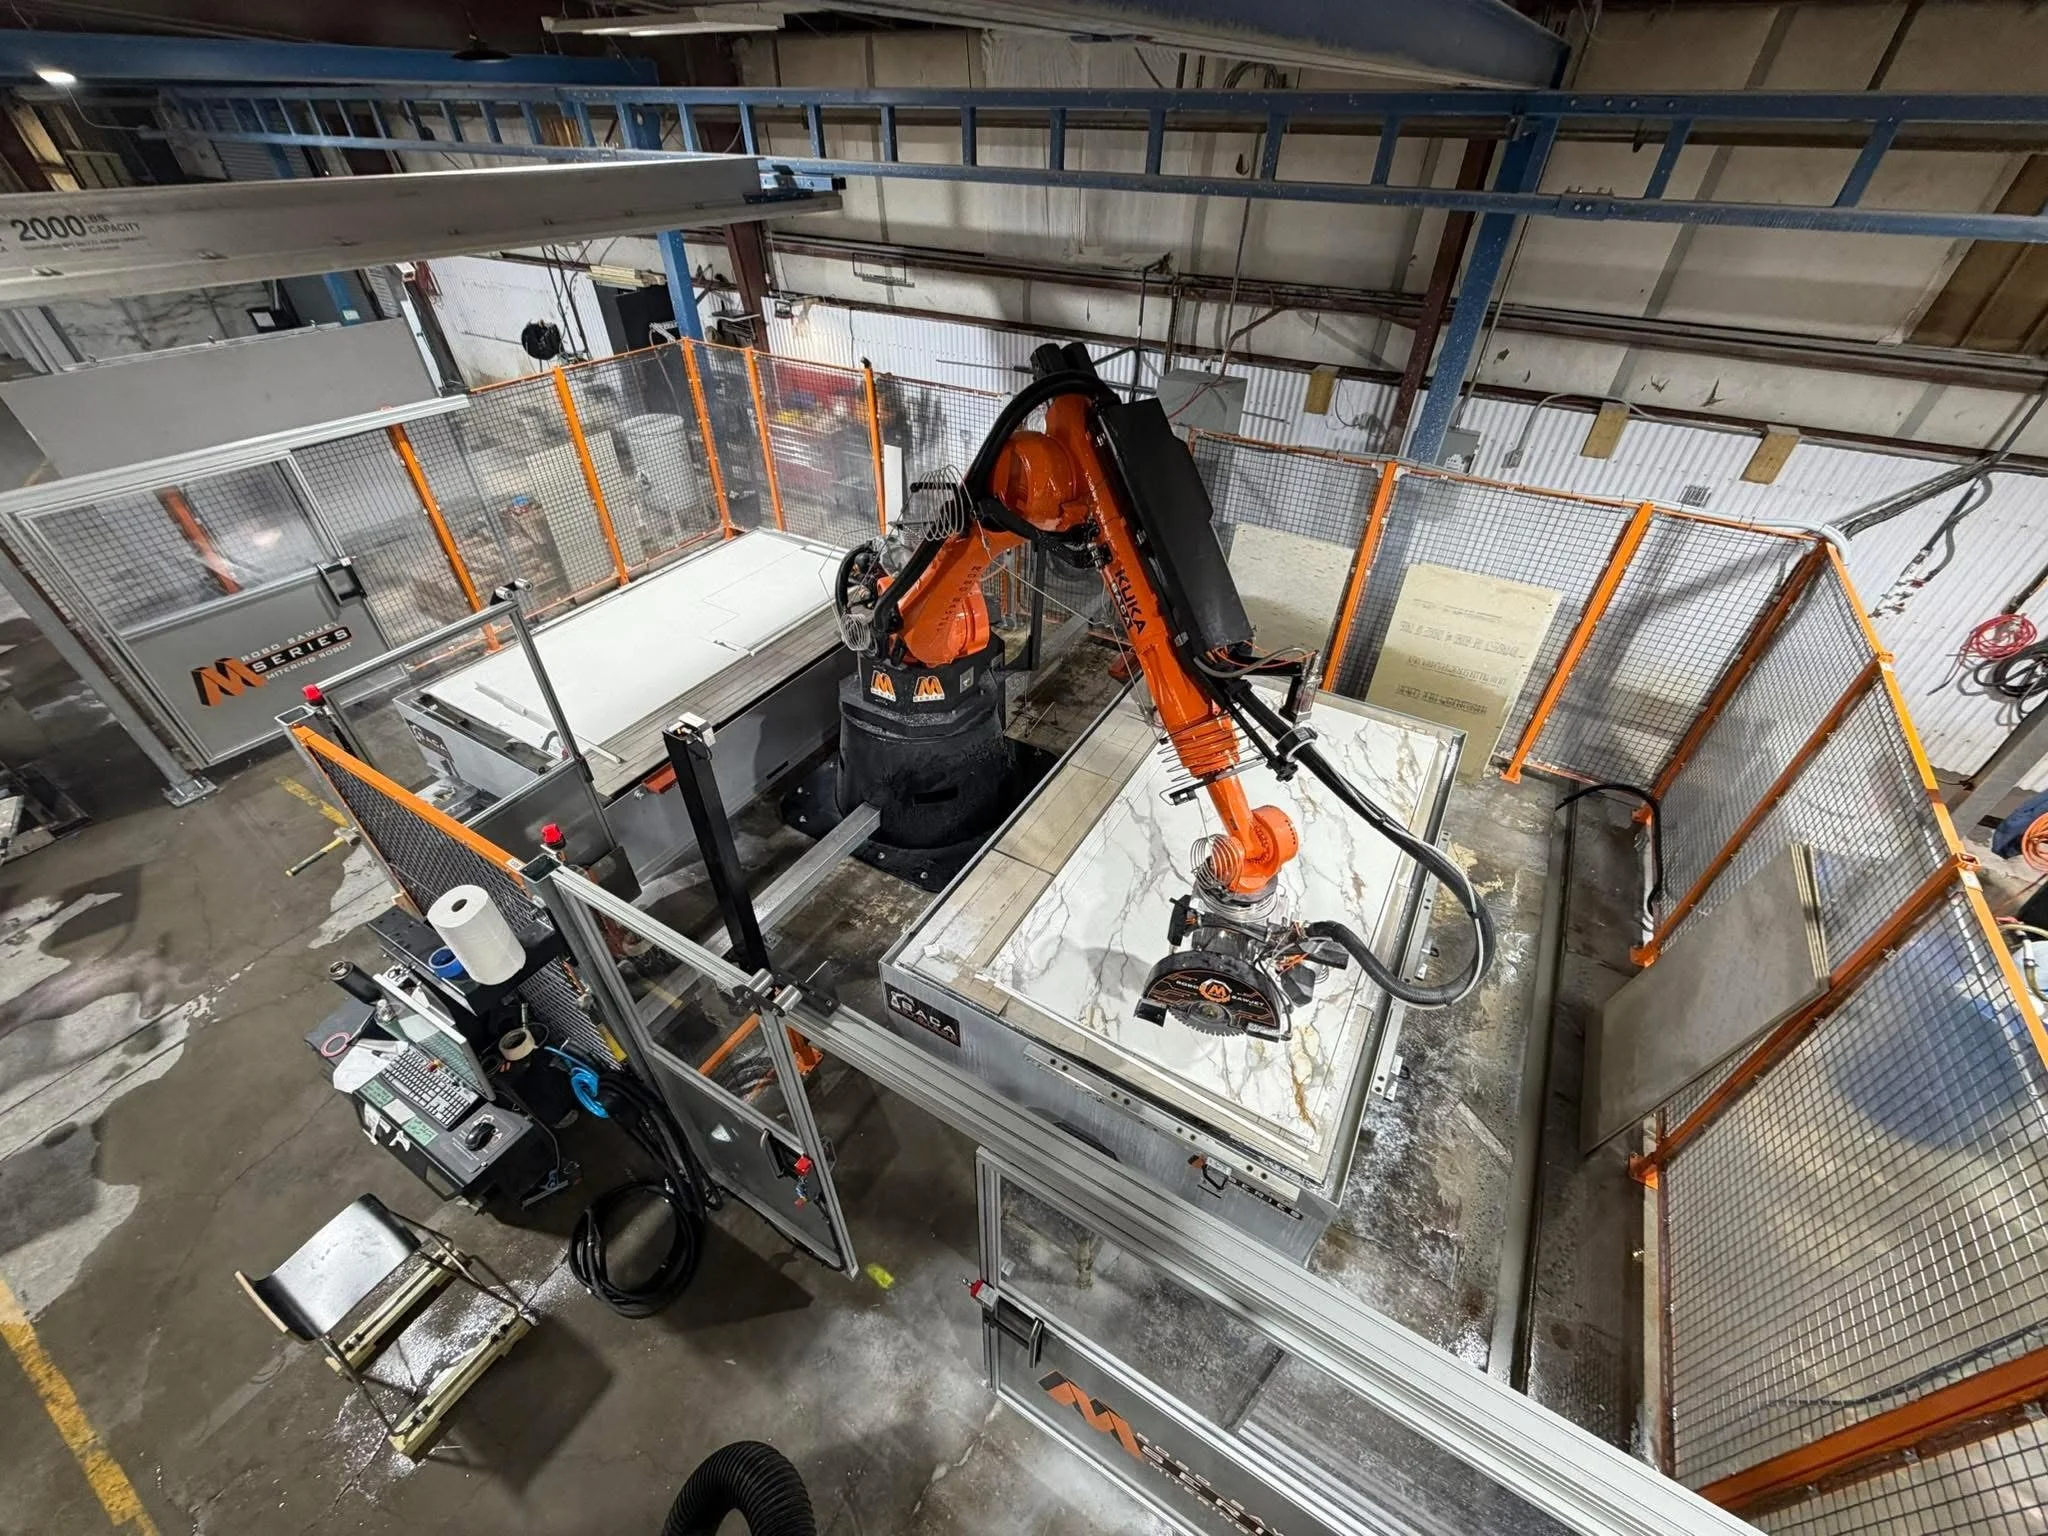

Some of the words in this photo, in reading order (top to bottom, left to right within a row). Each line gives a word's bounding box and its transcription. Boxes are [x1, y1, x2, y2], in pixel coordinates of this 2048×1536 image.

[10, 215, 87, 241] 2000
[88, 222, 140, 235] CAPACITY
[1115, 569, 1146, 634] KUKA
[240, 643, 281, 662] ROBO
[287, 621, 339, 645] SAWJET
[251, 629, 348, 673] SERIES
[265, 656, 317, 680] MITERING
[318, 641, 353, 659] ROBOT
[901, 1000, 956, 1037] BACA
[1136, 1432, 1211, 1487] ROBO
